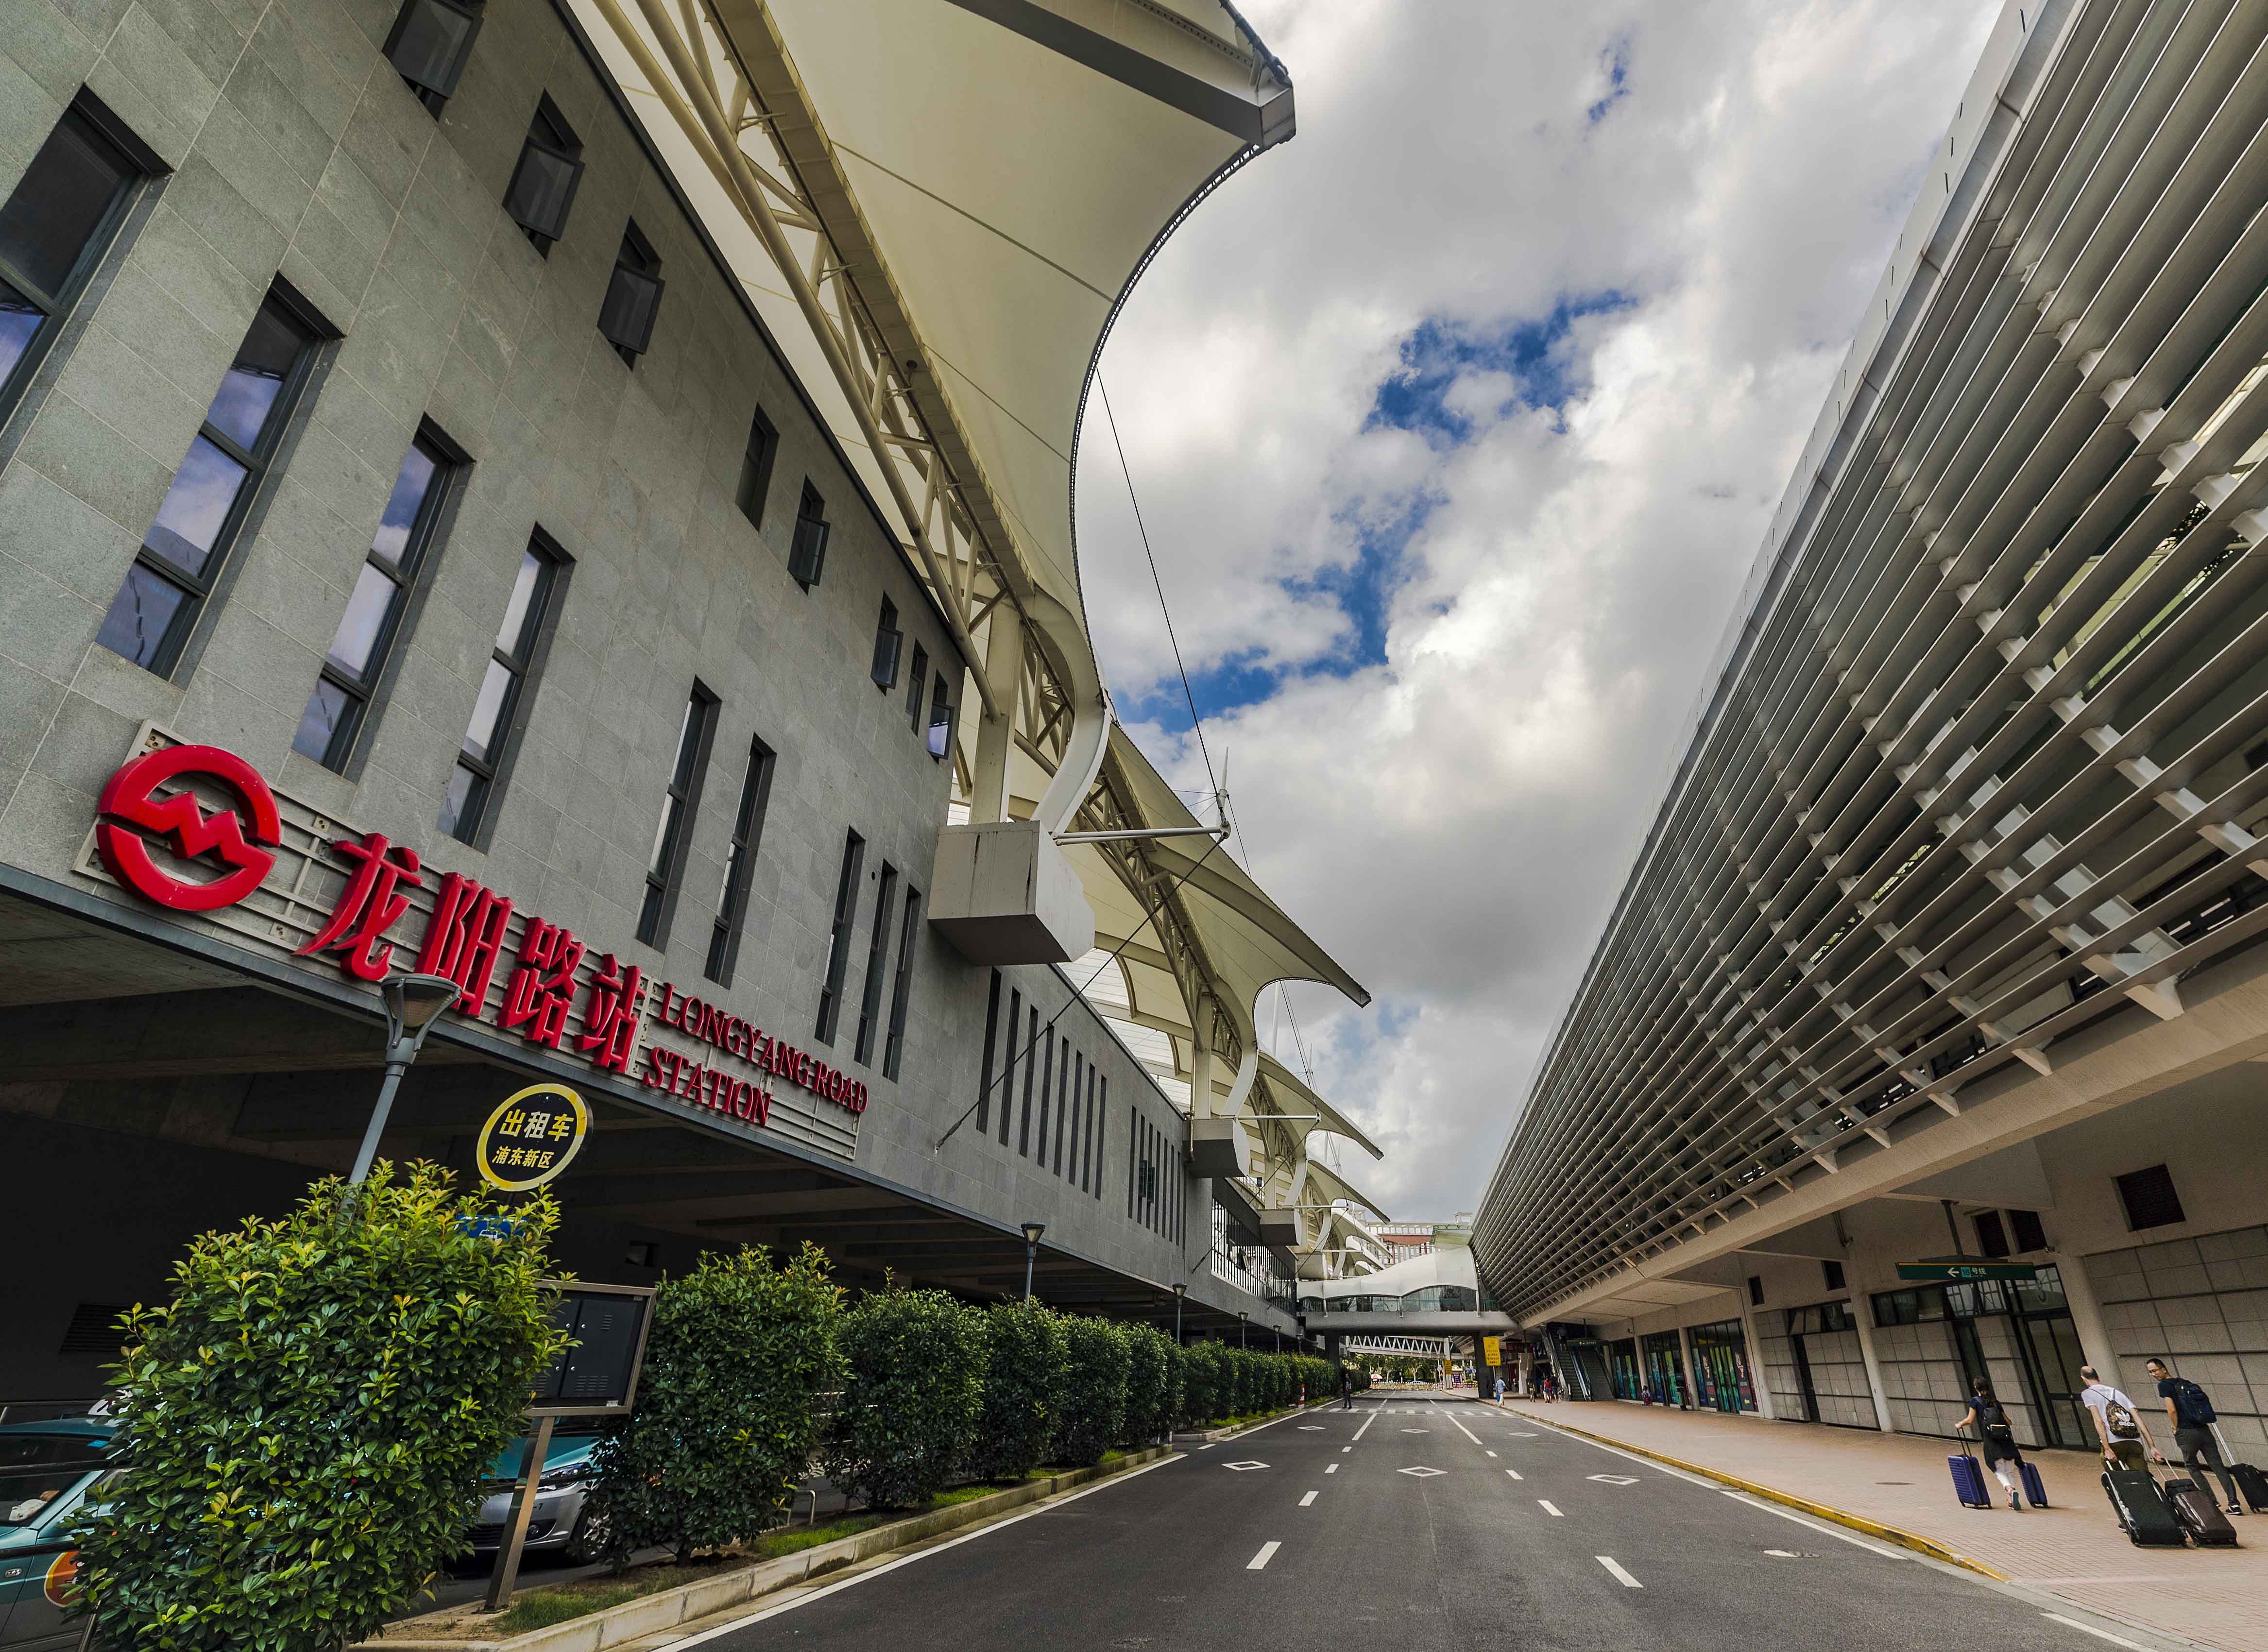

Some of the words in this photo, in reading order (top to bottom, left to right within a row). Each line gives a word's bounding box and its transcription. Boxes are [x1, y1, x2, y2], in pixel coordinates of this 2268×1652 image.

[291, 833, 645, 1074] 龙阳路站
[642, 1047, 773, 1127] STATION
[658, 982, 812, 1086] LONGYANG
[812, 1060, 869, 1113] ROAD
[492, 1146, 554, 1169] 浦东新区
[499, 1109, 574, 1141] 出租车
